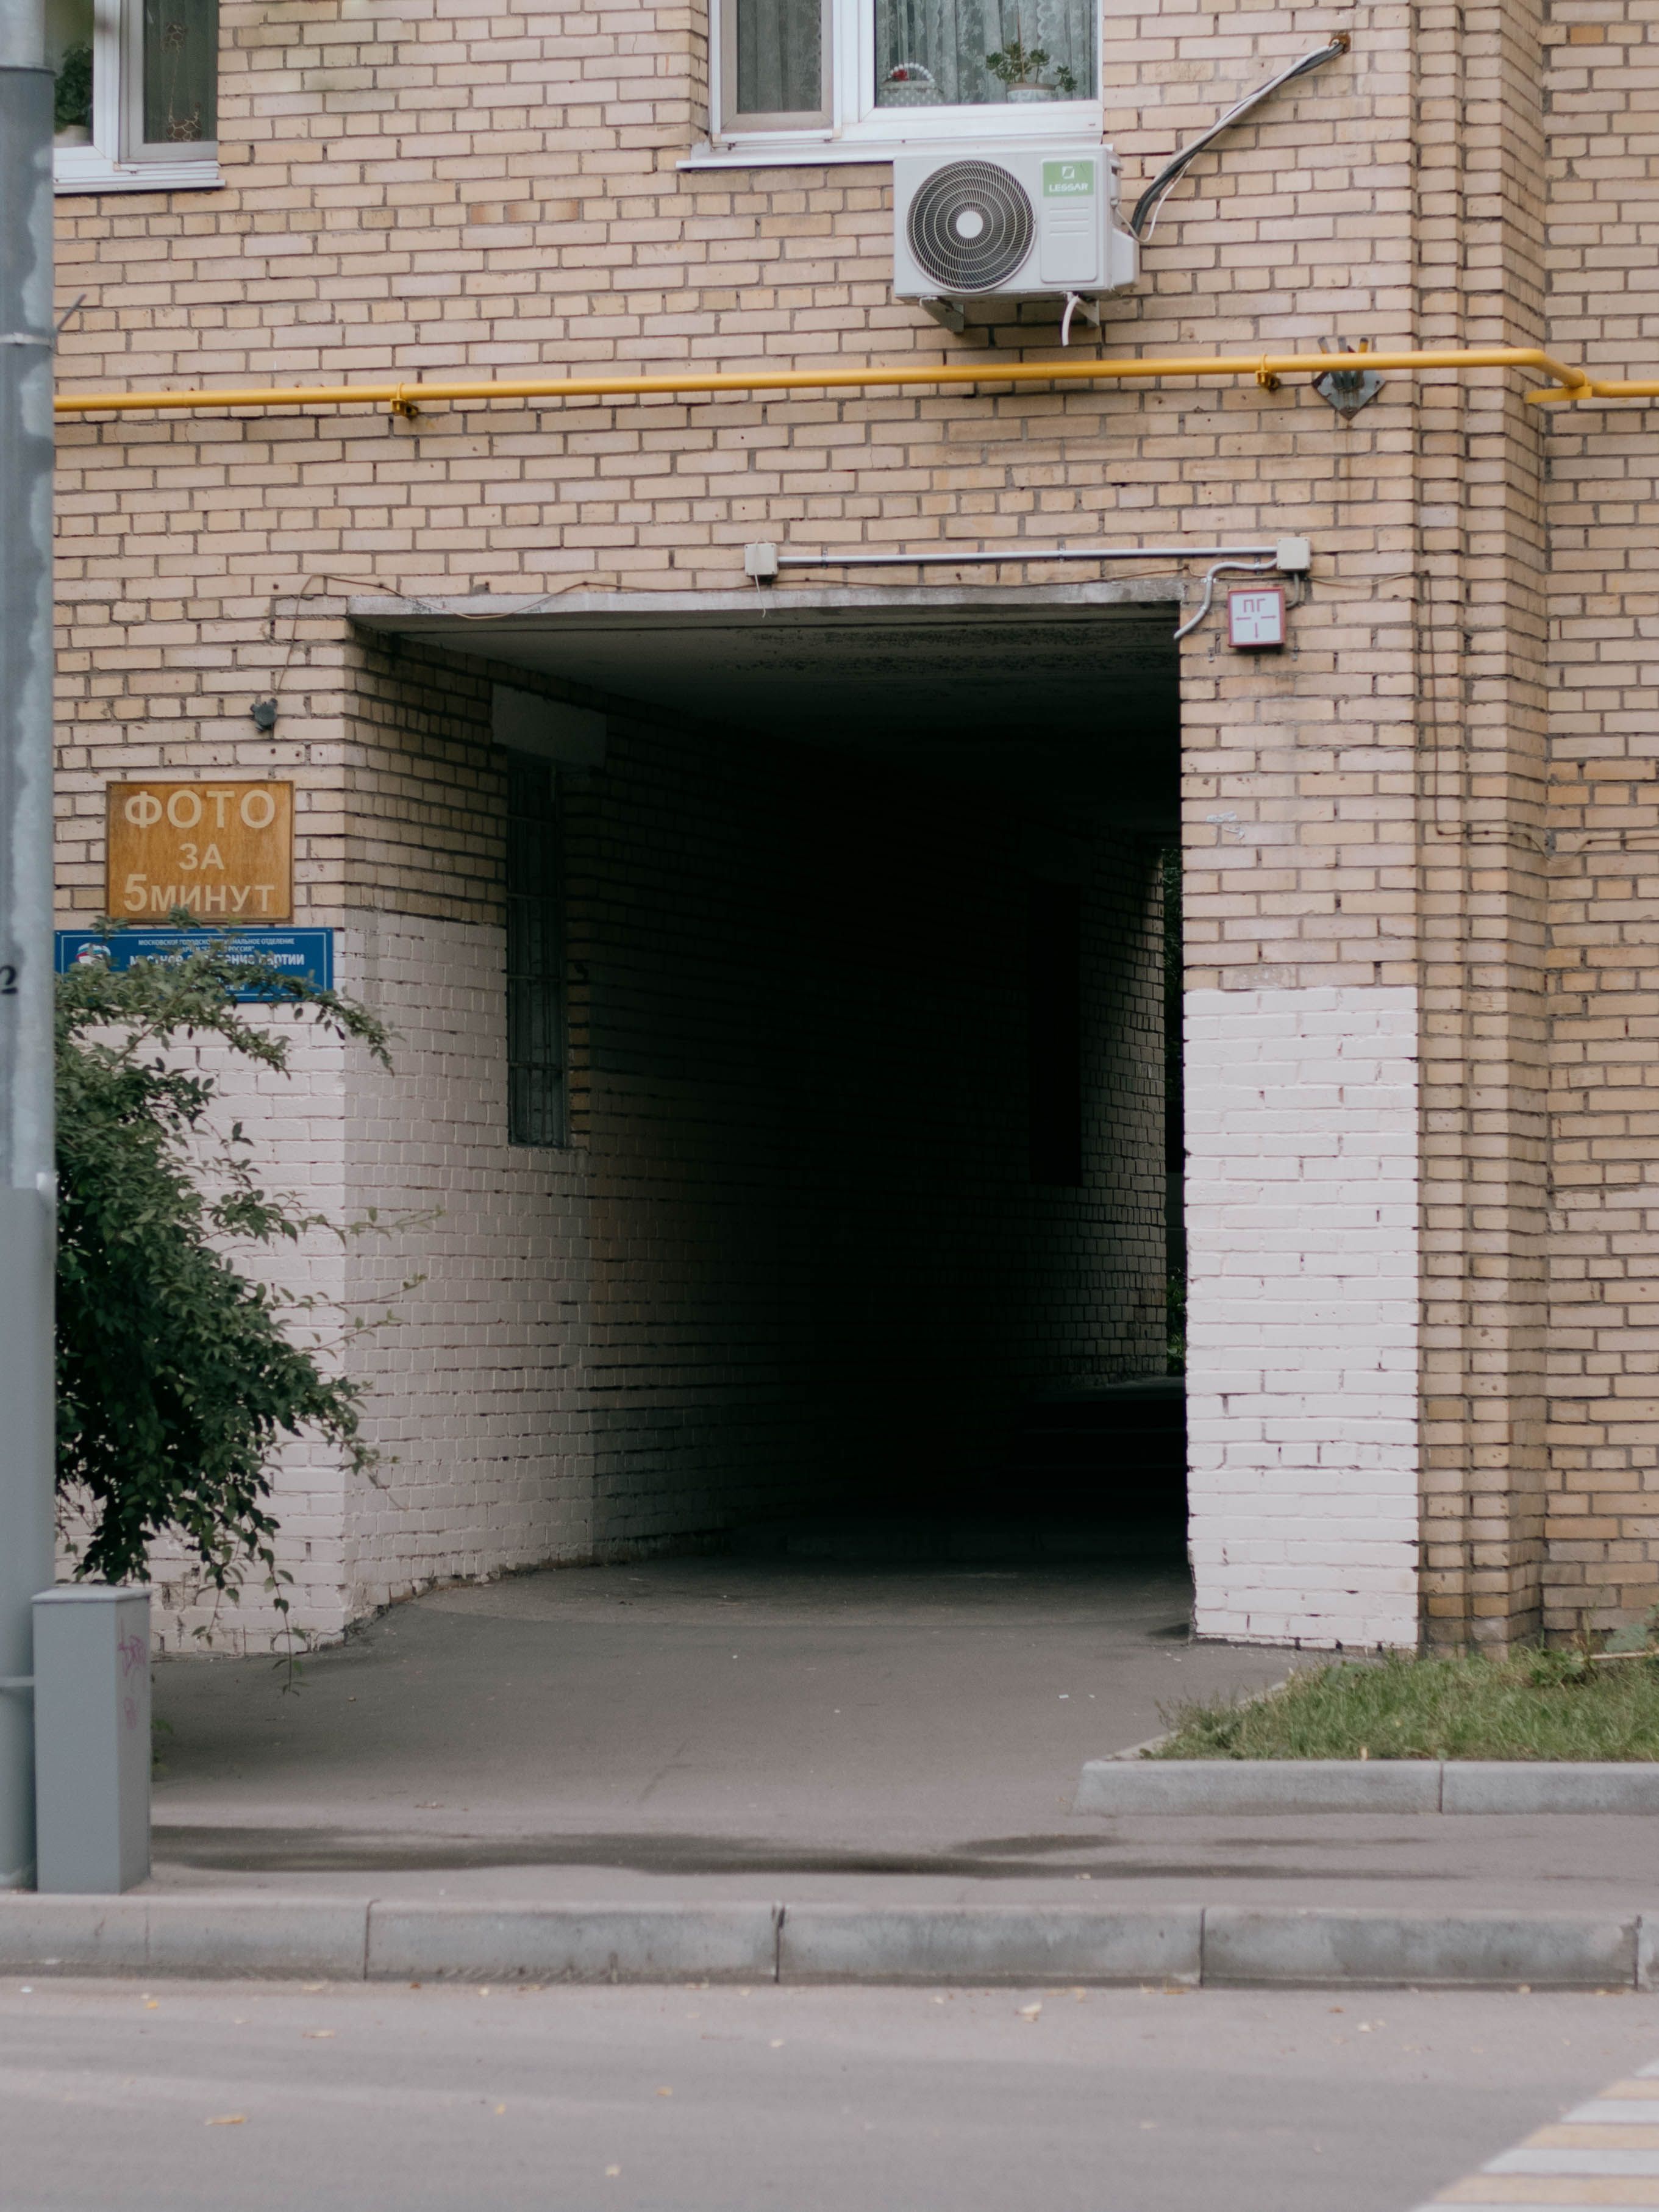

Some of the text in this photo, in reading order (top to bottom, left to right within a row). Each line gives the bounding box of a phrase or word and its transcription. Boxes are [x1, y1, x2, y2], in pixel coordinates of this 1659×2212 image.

[1049, 182, 1088, 192] LESSAR
[1243, 598, 1266, 613] ПГ
[124, 790, 276, 829] ФОТО
[179, 843, 224, 871] ЗА
